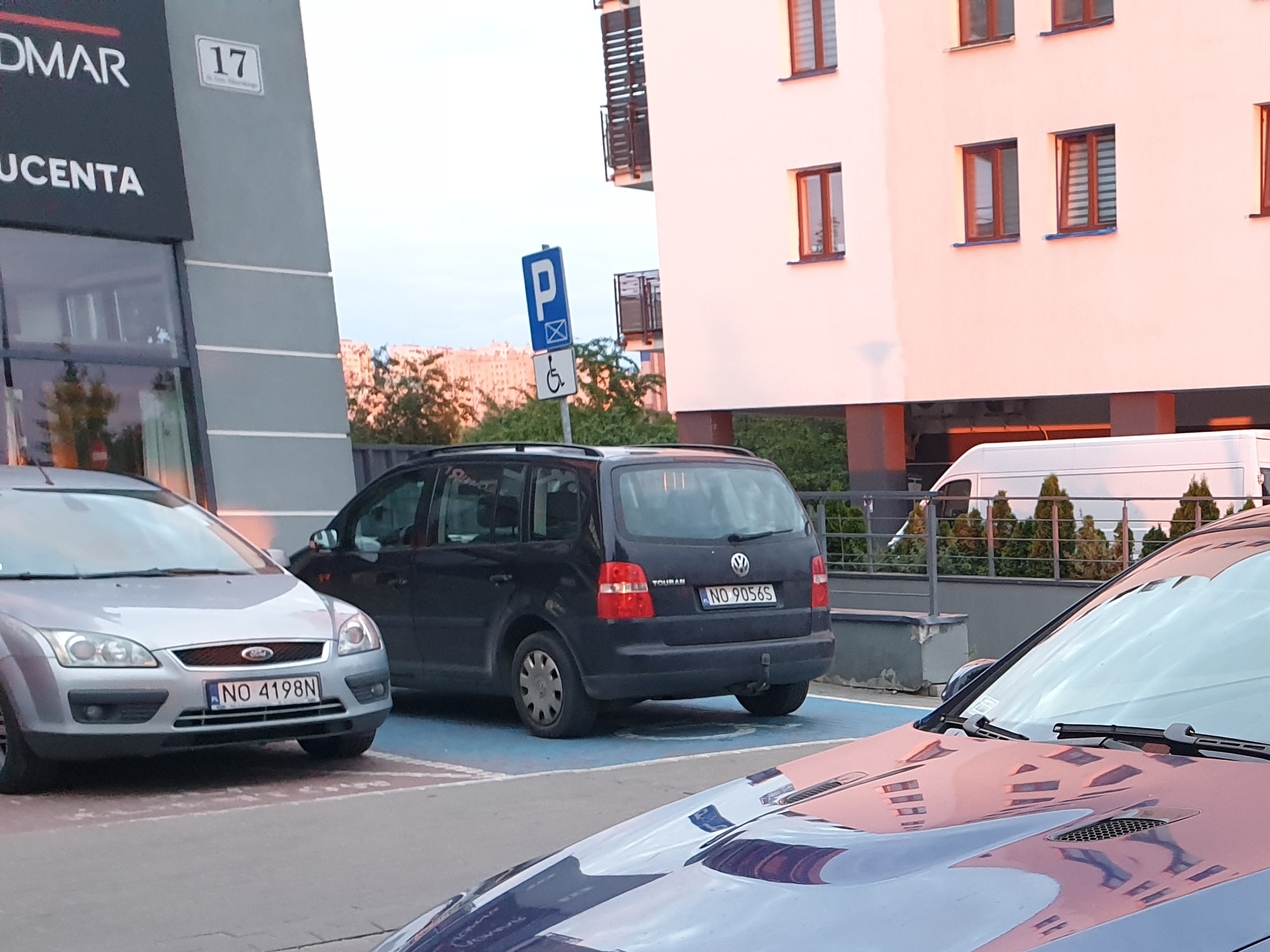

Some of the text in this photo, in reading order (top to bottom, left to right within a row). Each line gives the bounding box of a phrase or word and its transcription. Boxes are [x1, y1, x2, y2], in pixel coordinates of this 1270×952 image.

[210, 46, 246, 78] 17
[652, 578, 686, 587] TOURAN
[709, 585, 773, 603] NO 9056S
[222, 678, 316, 703] NO 4198N
